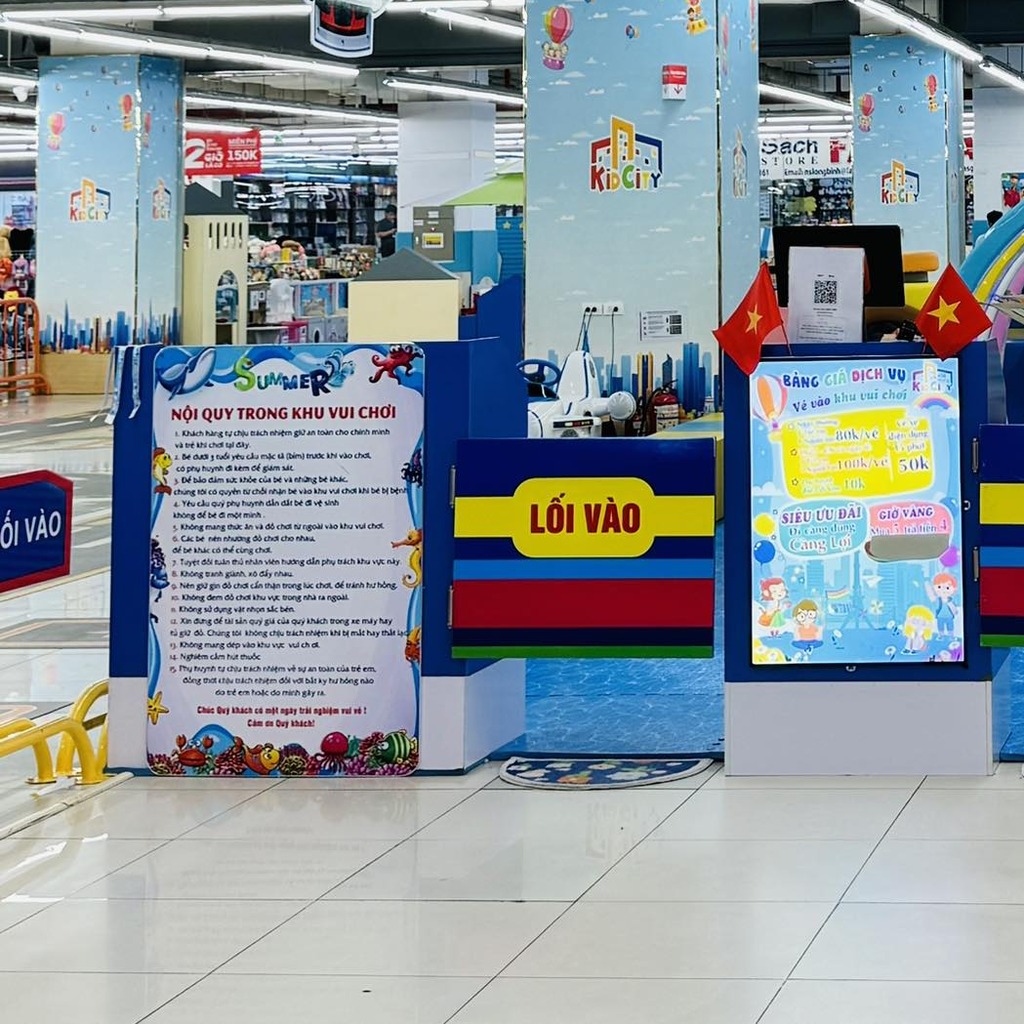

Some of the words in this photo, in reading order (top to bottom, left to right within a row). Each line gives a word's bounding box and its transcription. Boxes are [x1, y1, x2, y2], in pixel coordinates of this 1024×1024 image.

[782, 371, 819, 388] BẢNG
[852, 368, 883, 384] DỊCH
[888, 368, 906, 383] VỤ
[171, 405, 198, 424] NỘI
[202, 407, 234, 423] QUY
[237, 407, 288, 420] TRONG
[292, 406, 325, 420] KHU
[328, 406, 355, 419] VUI
[358, 404, 396, 419] CHƠI
[530, 492, 575, 534] LỐI
[584, 496, 641, 534] VÀO
[0, 509, 19, 549] ỐI
[24, 508, 61, 543] VÀO
